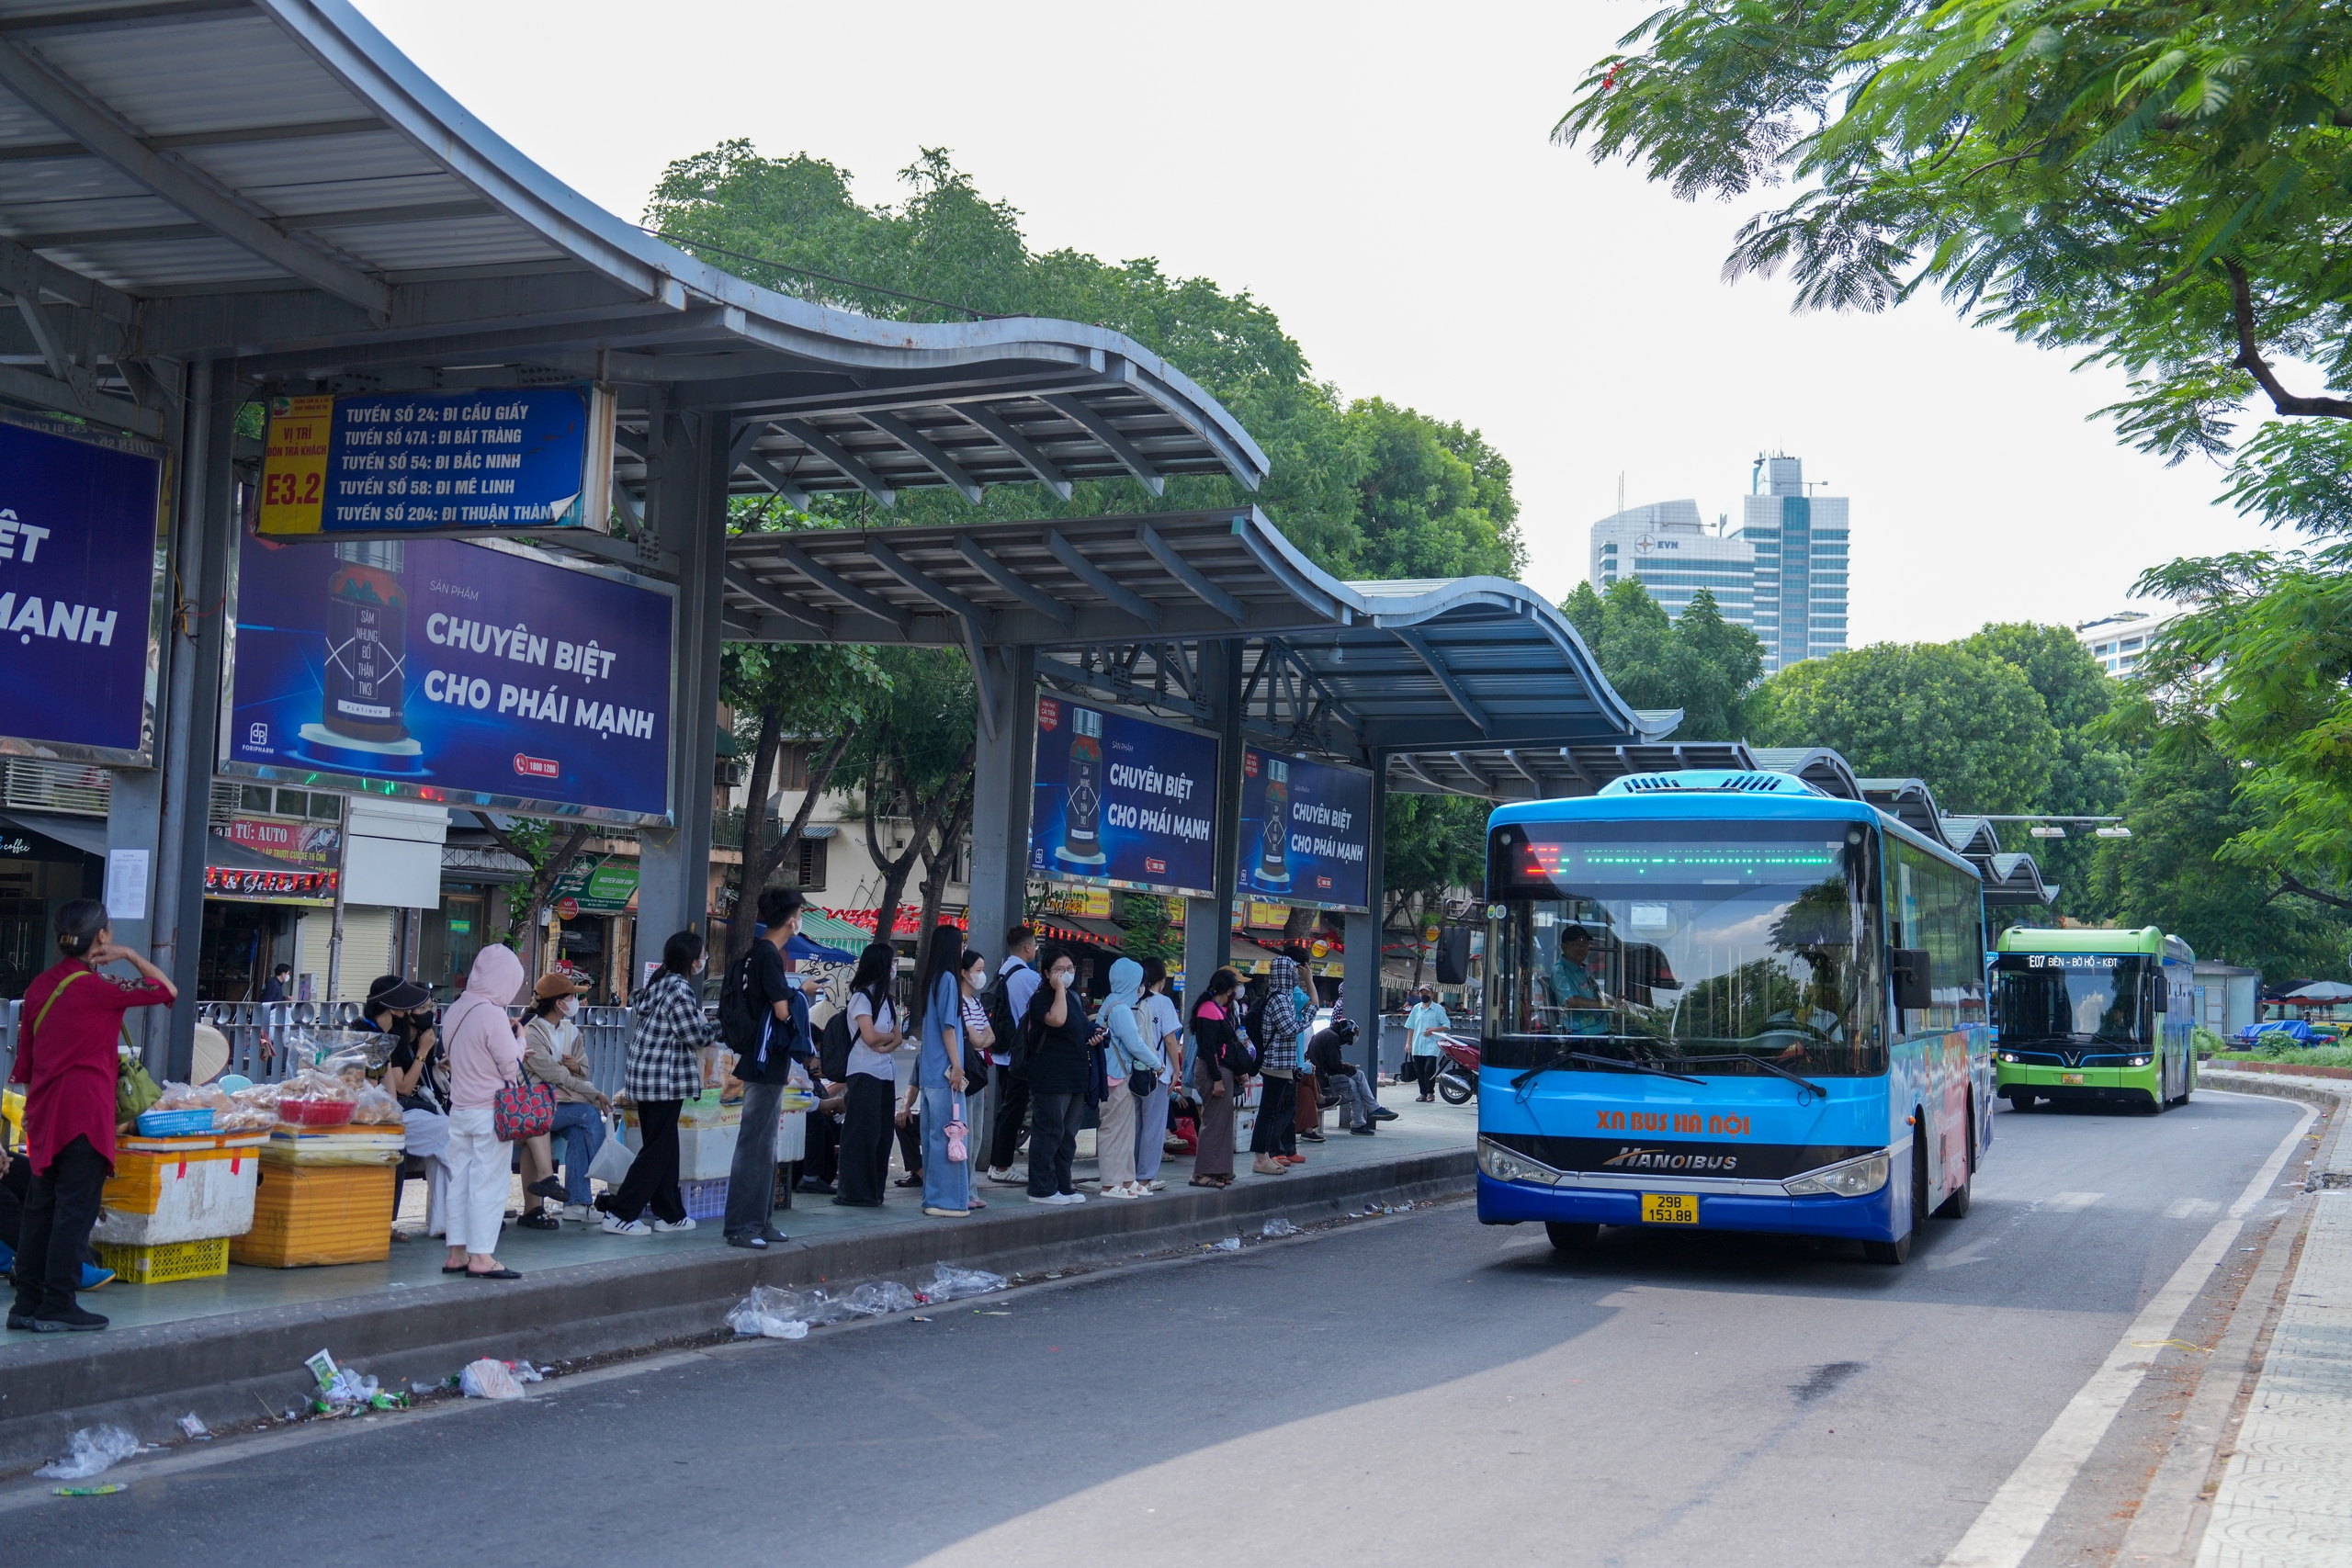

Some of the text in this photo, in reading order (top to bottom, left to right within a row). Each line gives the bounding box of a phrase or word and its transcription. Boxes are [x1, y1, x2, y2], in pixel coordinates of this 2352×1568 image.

[346, 400, 528, 423] TUYẾN SỐ 24: ĐI CẦU GIẤY
[284, 424, 312, 444] VỊ TRÍ
[345, 426, 382, 446] TUYẾN
[386, 426, 403, 445] SỐ
[405, 430, 428, 445] 47A
[438, 430, 451, 445] ĐI
[454, 426, 478, 445] BÁT
[481, 426, 522, 443] TRÀNG
[266, 442, 327, 457] ĐÓN TRẢ KHÁCH
[343, 449, 521, 469] TUYẾN SỐ 54: ĐI BẮC NINH
[266, 472, 321, 506] E3.2
[339, 475, 514, 495] TUYẾN SỐ 58: ĐI MÊ LINH
[337, 502, 381, 522] TUYẾN
[385, 502, 406, 522] SỐ
[408, 506, 438, 521] 204:
[442, 506, 457, 521] ĐI
[461, 502, 509, 527] THUẬN
[1657, 541, 1679, 549] EVN
[429, 579, 479, 602] SẢN PHẨM
[361, 609, 375, 625] SÂM
[356, 626, 378, 643] NHUNG
[362, 642, 371, 660] BỔ
[426, 613, 616, 684] CHUYÊN BIỆT
[357, 661, 374, 678] THẬN
[358, 681, 372, 696] TW3
[346, 705, 383, 715] PLATINUM
[424, 670, 655, 740] CHO PHÁI MẠNH
[242, 744, 275, 753] FORIPHARM
[529, 761, 556, 773] 1800 1286
[1109, 762, 1193, 805] CHUYÊN BIỆT
[1107, 803, 1210, 844] CHO PHÁI MẠNH
[1293, 802, 1352, 833] CHUYÊN BIỆT
[236, 821, 288, 843] TỨ: AUTO
[4, 838, 30, 853] coffee
[1291, 833, 1363, 864] CHO PHÁI MẠNH
[2030, 955, 2045, 967] E07
[2072, 955, 2083, 966] BỜ
[2084, 954, 2095, 967] HỒ
[2102, 958, 2118, 967] KĐT
[1631, 1111, 1668, 1132] BUS
[1673, 1110, 1702, 1134] HÀ
[1708, 1111, 1750, 1139] NỘI
[1608, 1146, 1737, 1170] HANOIBUS
[1657, 1196, 1681, 1208] 29B
[1649, 1209, 1692, 1222] 153.88
